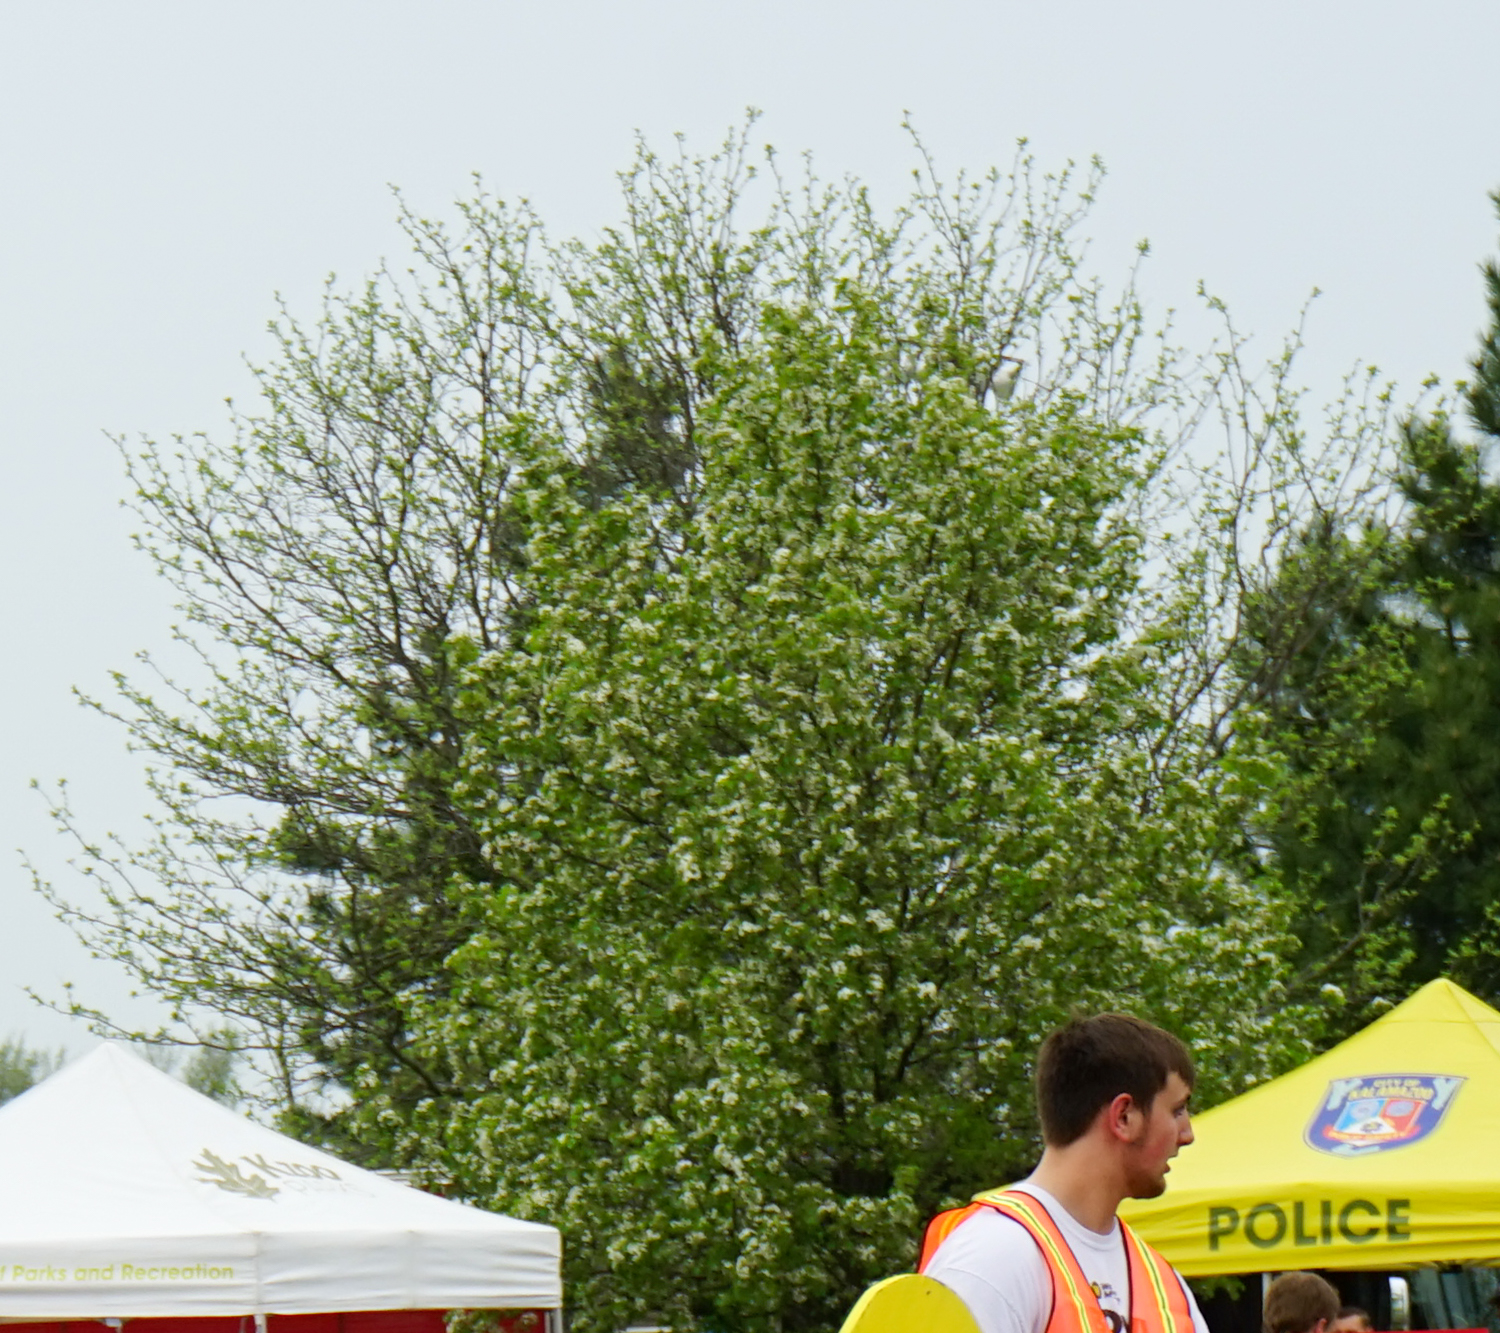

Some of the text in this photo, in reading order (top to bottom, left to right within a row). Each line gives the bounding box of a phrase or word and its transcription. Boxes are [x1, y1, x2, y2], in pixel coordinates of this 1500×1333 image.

[1208, 1199, 1411, 1251] POLICE
[12, 1264, 67, 1282] Parks
[73, 1264, 114, 1280] and
[120, 1262, 234, 1280] Recreation
